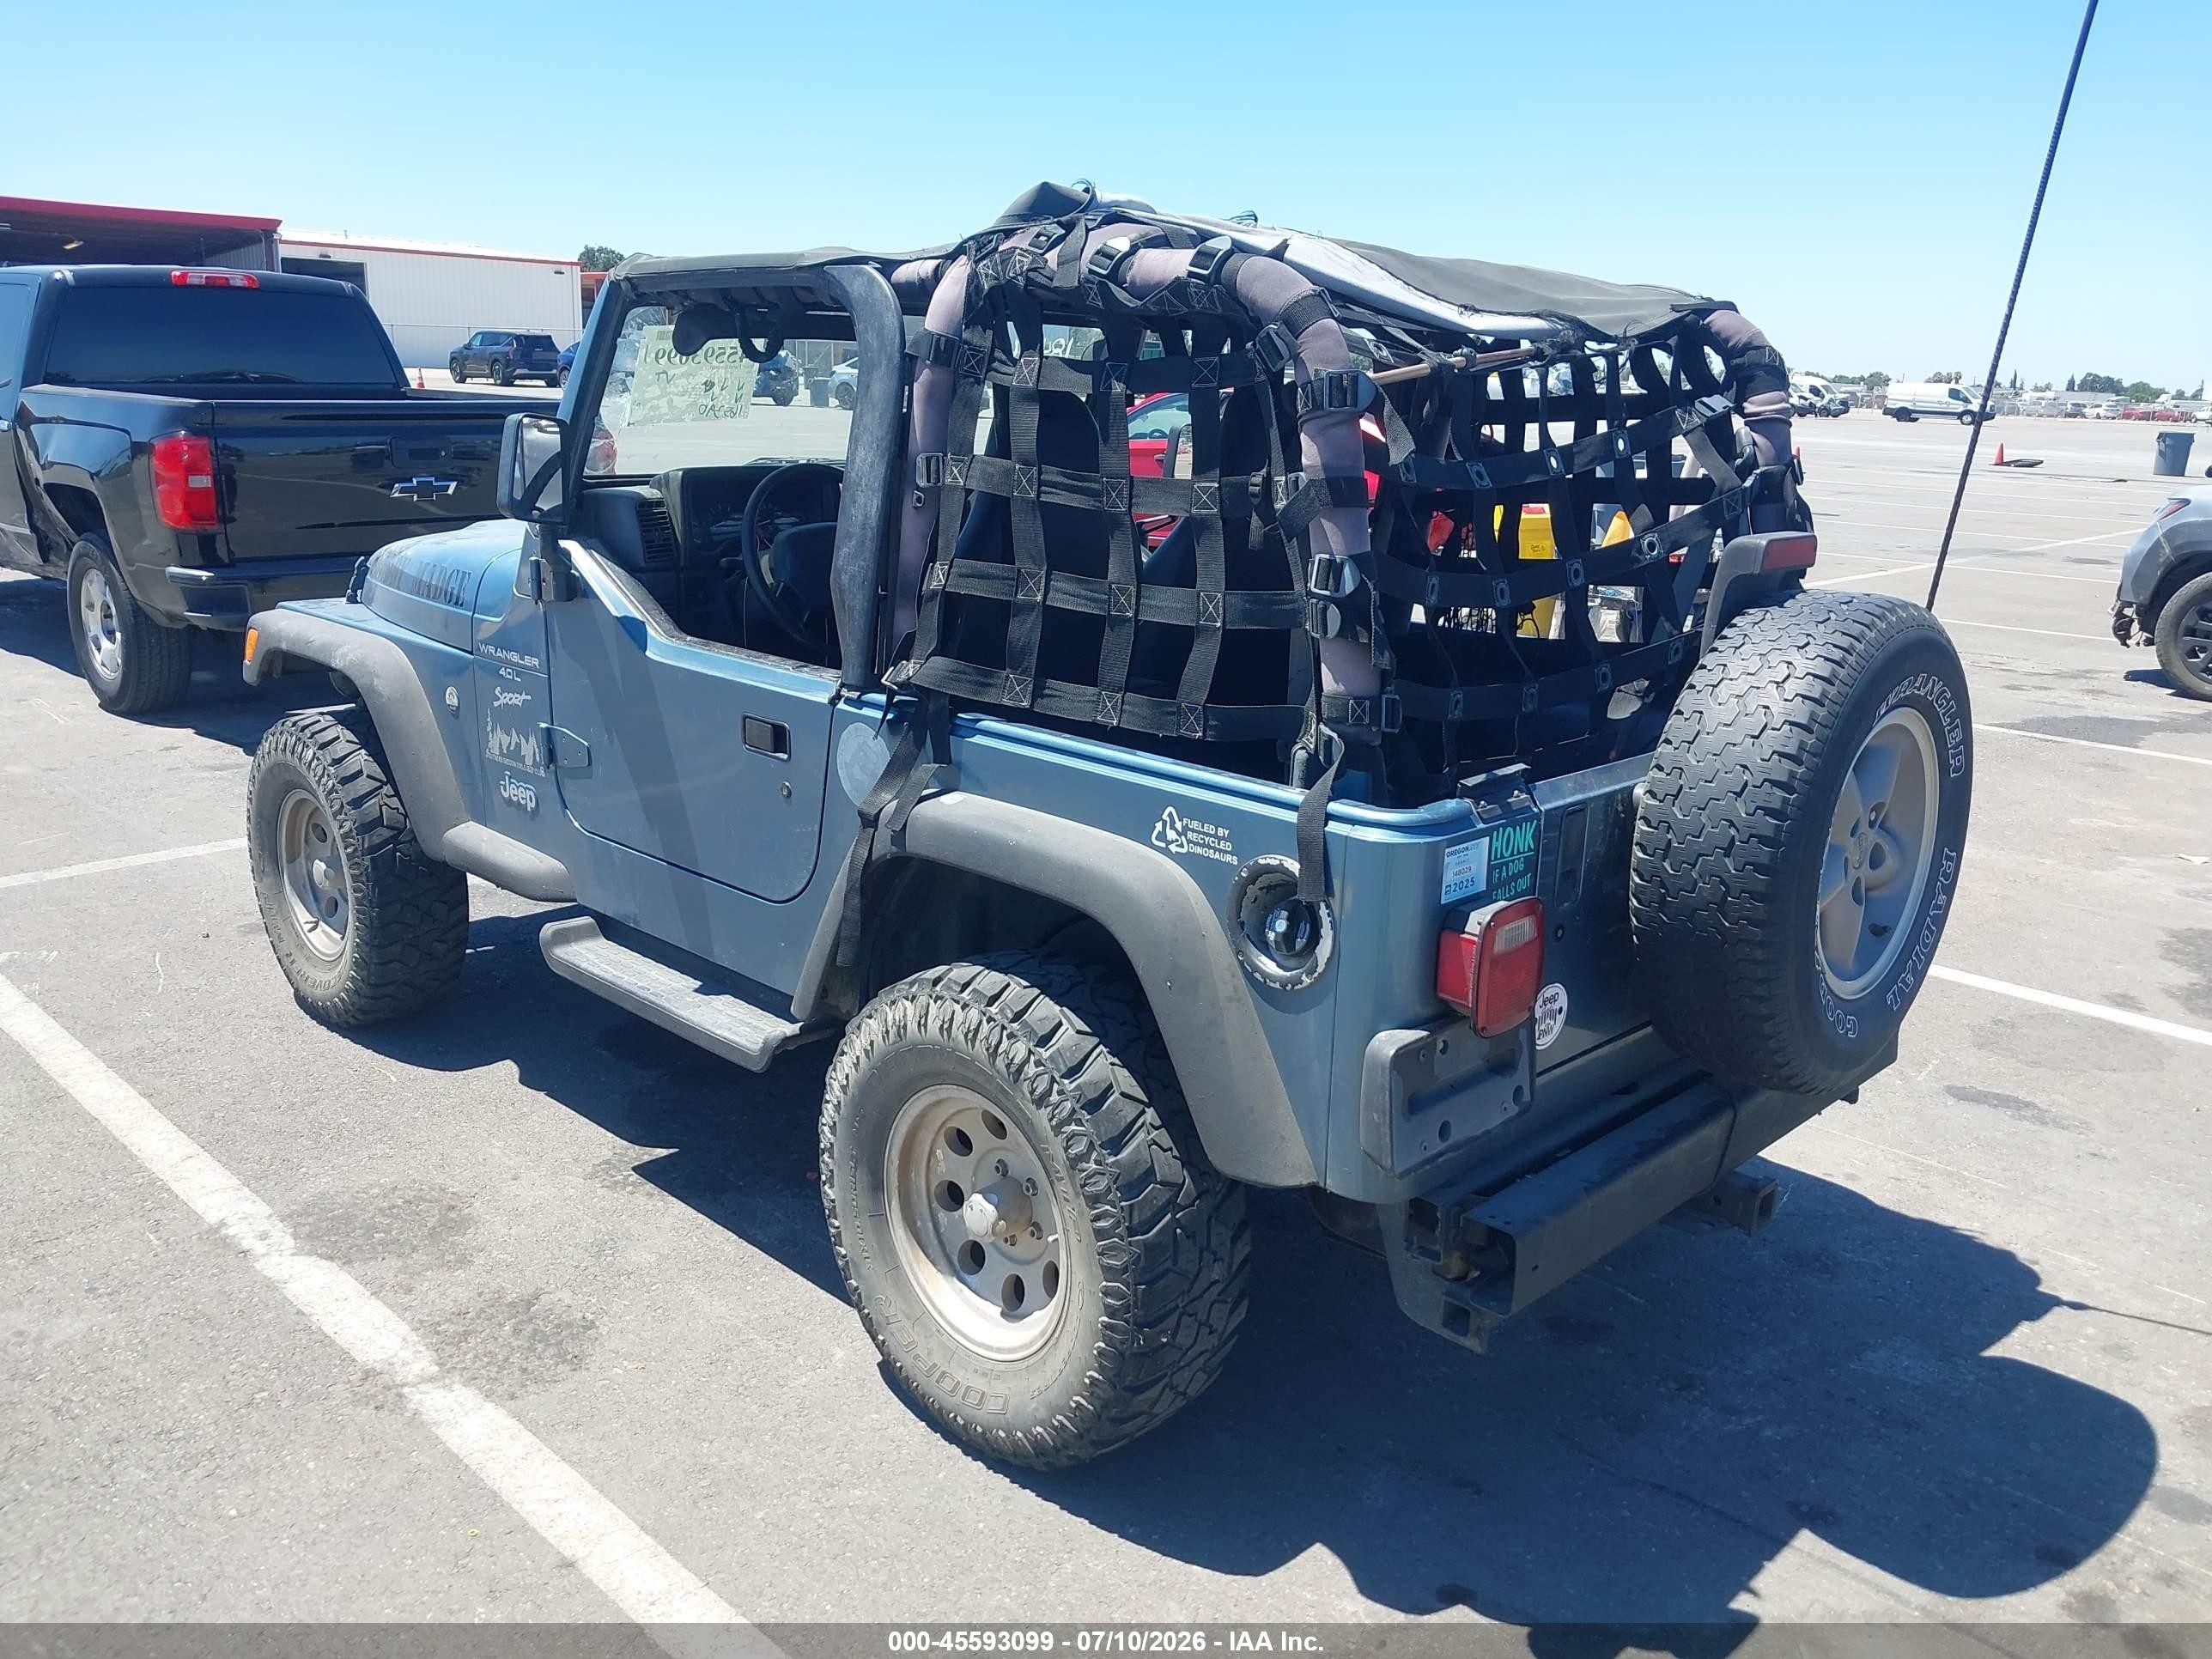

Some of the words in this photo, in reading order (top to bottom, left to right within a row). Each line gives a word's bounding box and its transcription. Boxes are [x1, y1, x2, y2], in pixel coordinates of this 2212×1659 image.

[478, 641, 540, 669] WRANGLER
[493, 686, 532, 709] Sport
[1873, 673, 1966, 778] WRANGLER
[500, 771, 537, 811] Jeep
[1182, 817, 1215, 835] FUELED
[1217, 826, 1230, 838] BY
[1187, 830, 1232, 851] RECYCLED
[1491, 819, 1537, 861] HONK
[1188, 843, 1238, 866] DINOSAURS
[1446, 845, 1469, 858] OREGON
[1492, 868, 1500, 884] IF
[1501, 865, 1507, 880] A
[1508, 857, 1524, 876] DOG
[1453, 876, 1474, 893] 2025
[1492, 881, 1515, 901] FALLS
[1516, 872, 1532, 892] OUT
[1886, 847, 1957, 1011] RADIAL
[1539, 992, 1559, 1009] Jeep
[873, 1294, 1011, 1414] COOPER
